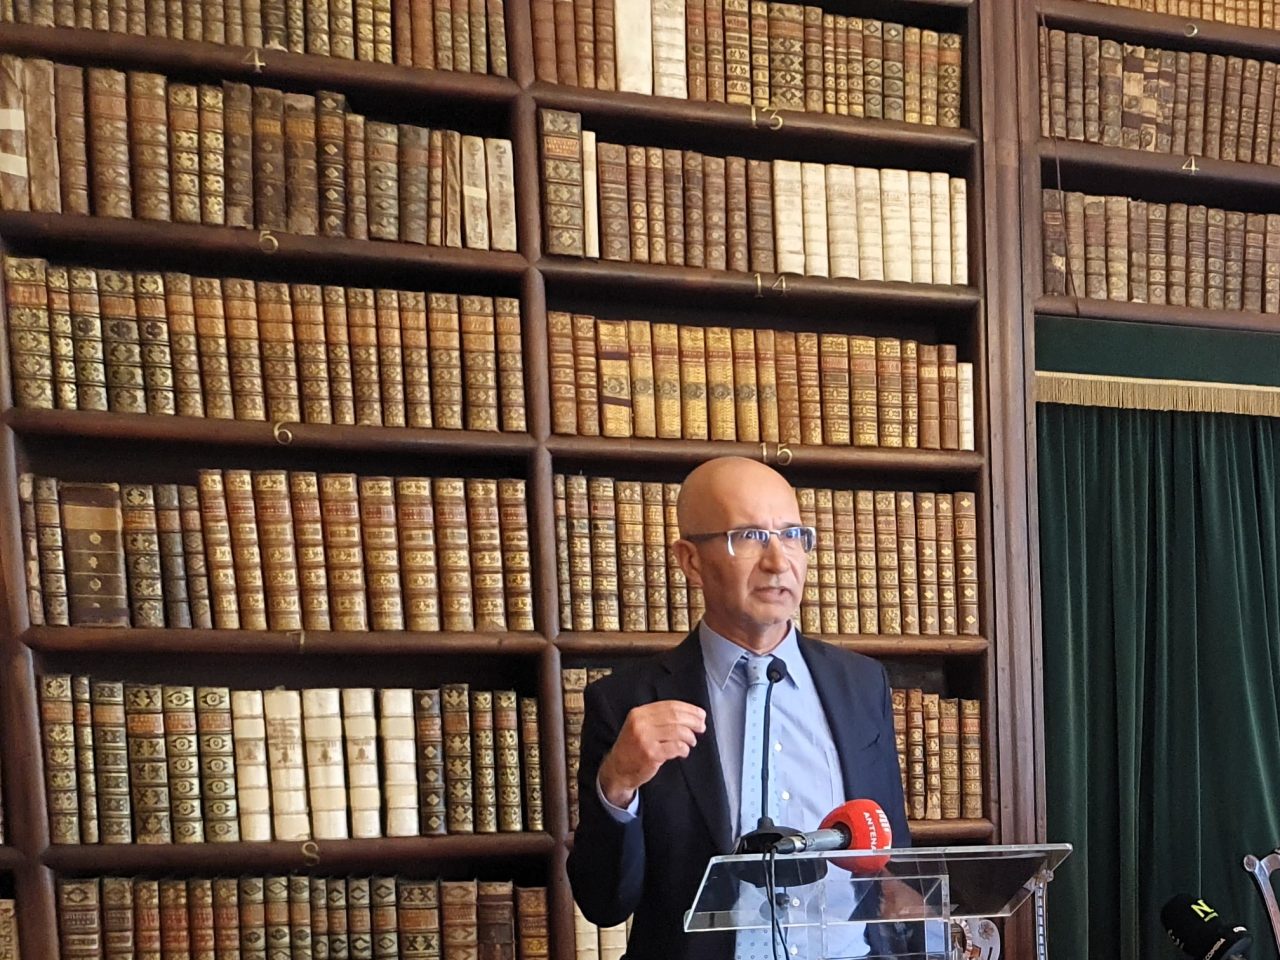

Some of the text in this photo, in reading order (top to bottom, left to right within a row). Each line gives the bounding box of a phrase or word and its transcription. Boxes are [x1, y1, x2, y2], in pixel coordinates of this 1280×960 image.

[240, 48, 267, 73] 4
[750, 104, 784, 130] 13
[1182, 155, 1200, 176] 4
[258, 230, 279, 254] 5
[753, 272, 792, 298] 14
[273, 421, 293, 446] 6
[759, 442, 793, 466] 15
[1190, 899, 1215, 919] N
